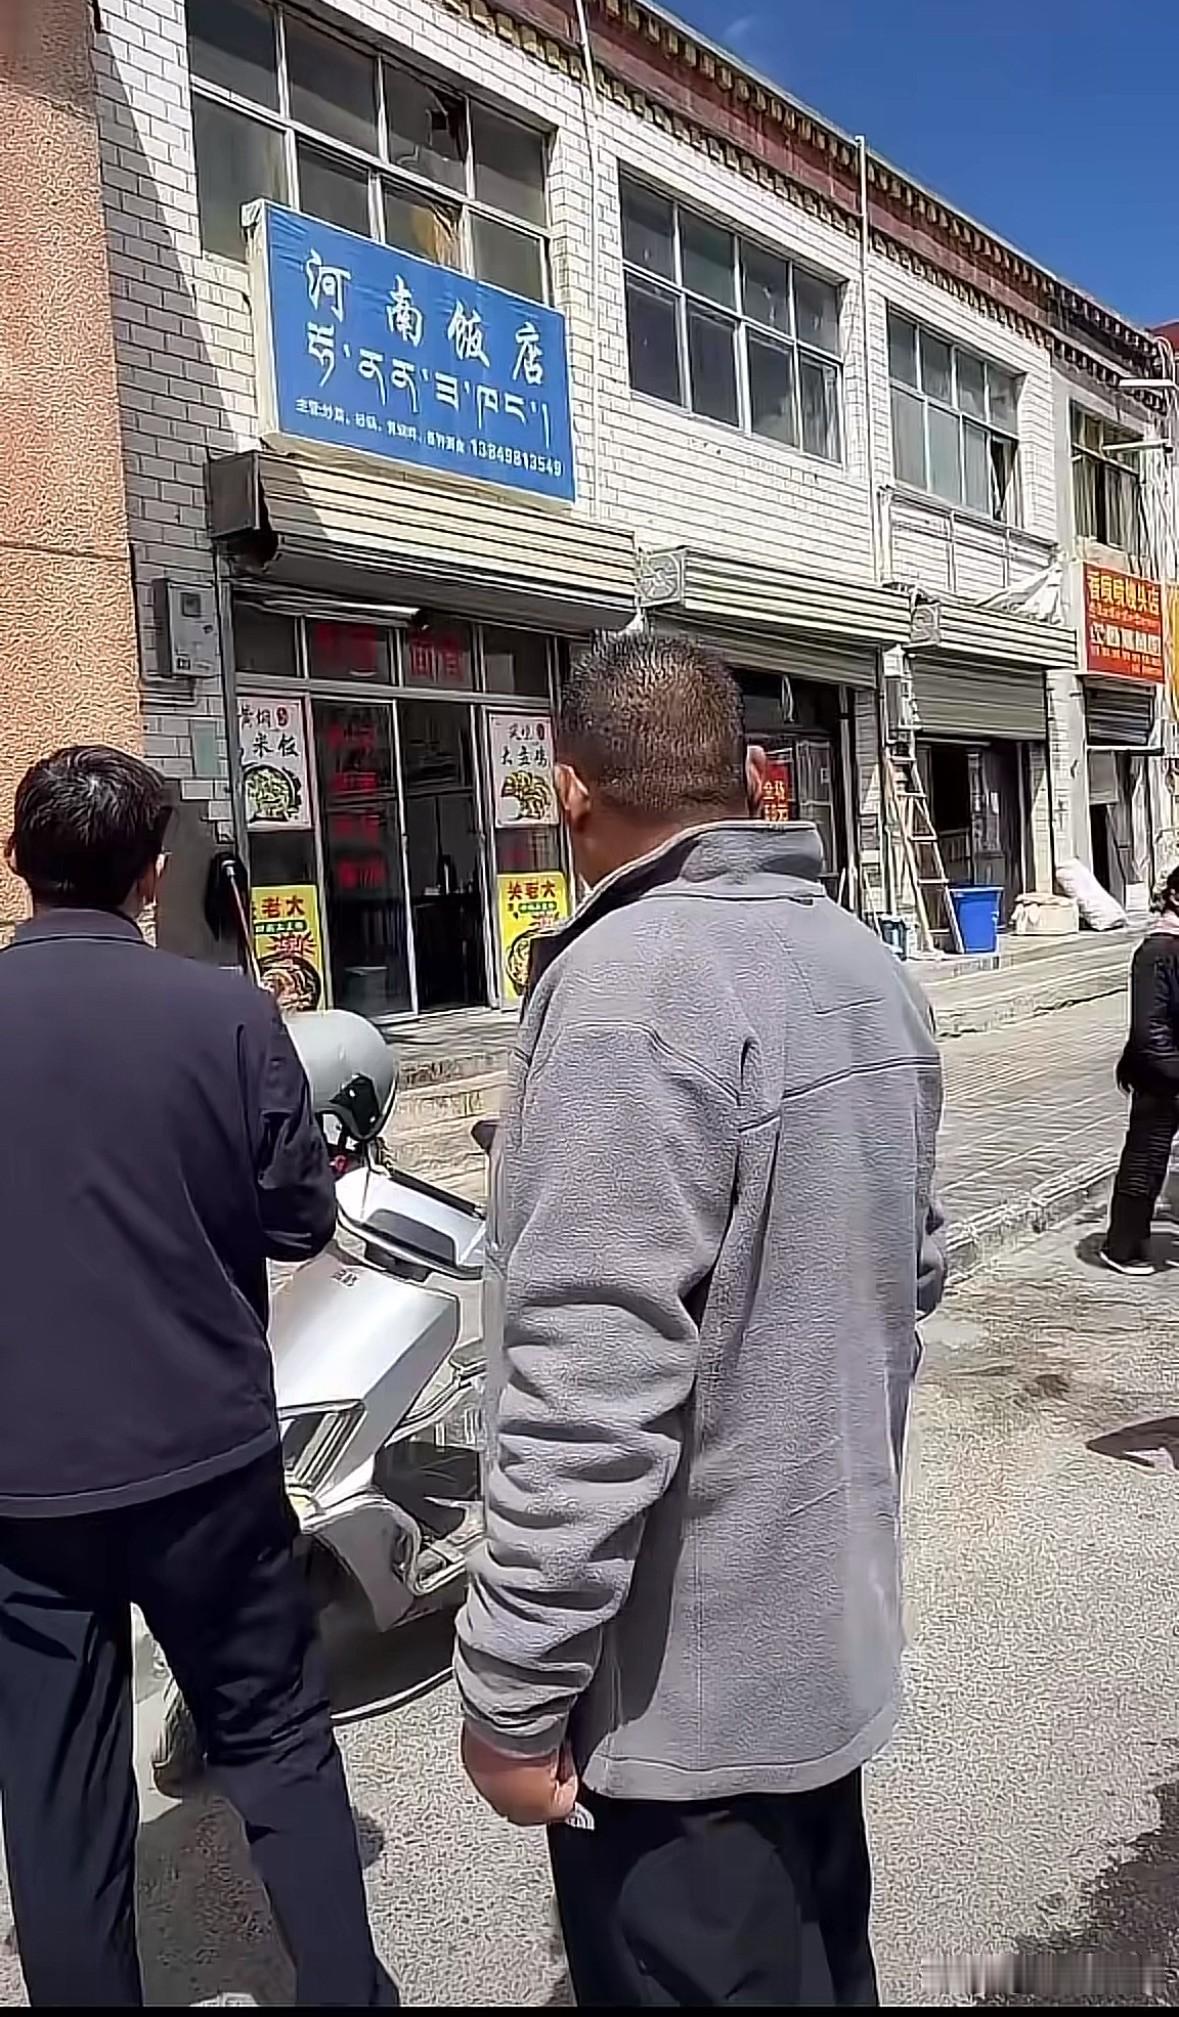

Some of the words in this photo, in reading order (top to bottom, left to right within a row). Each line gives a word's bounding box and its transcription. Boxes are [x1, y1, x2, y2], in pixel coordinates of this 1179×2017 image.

[305, 248, 544, 386] 河南饭店
[252, 731, 300, 758] 米饭
[252, 895, 305, 919] 老大
